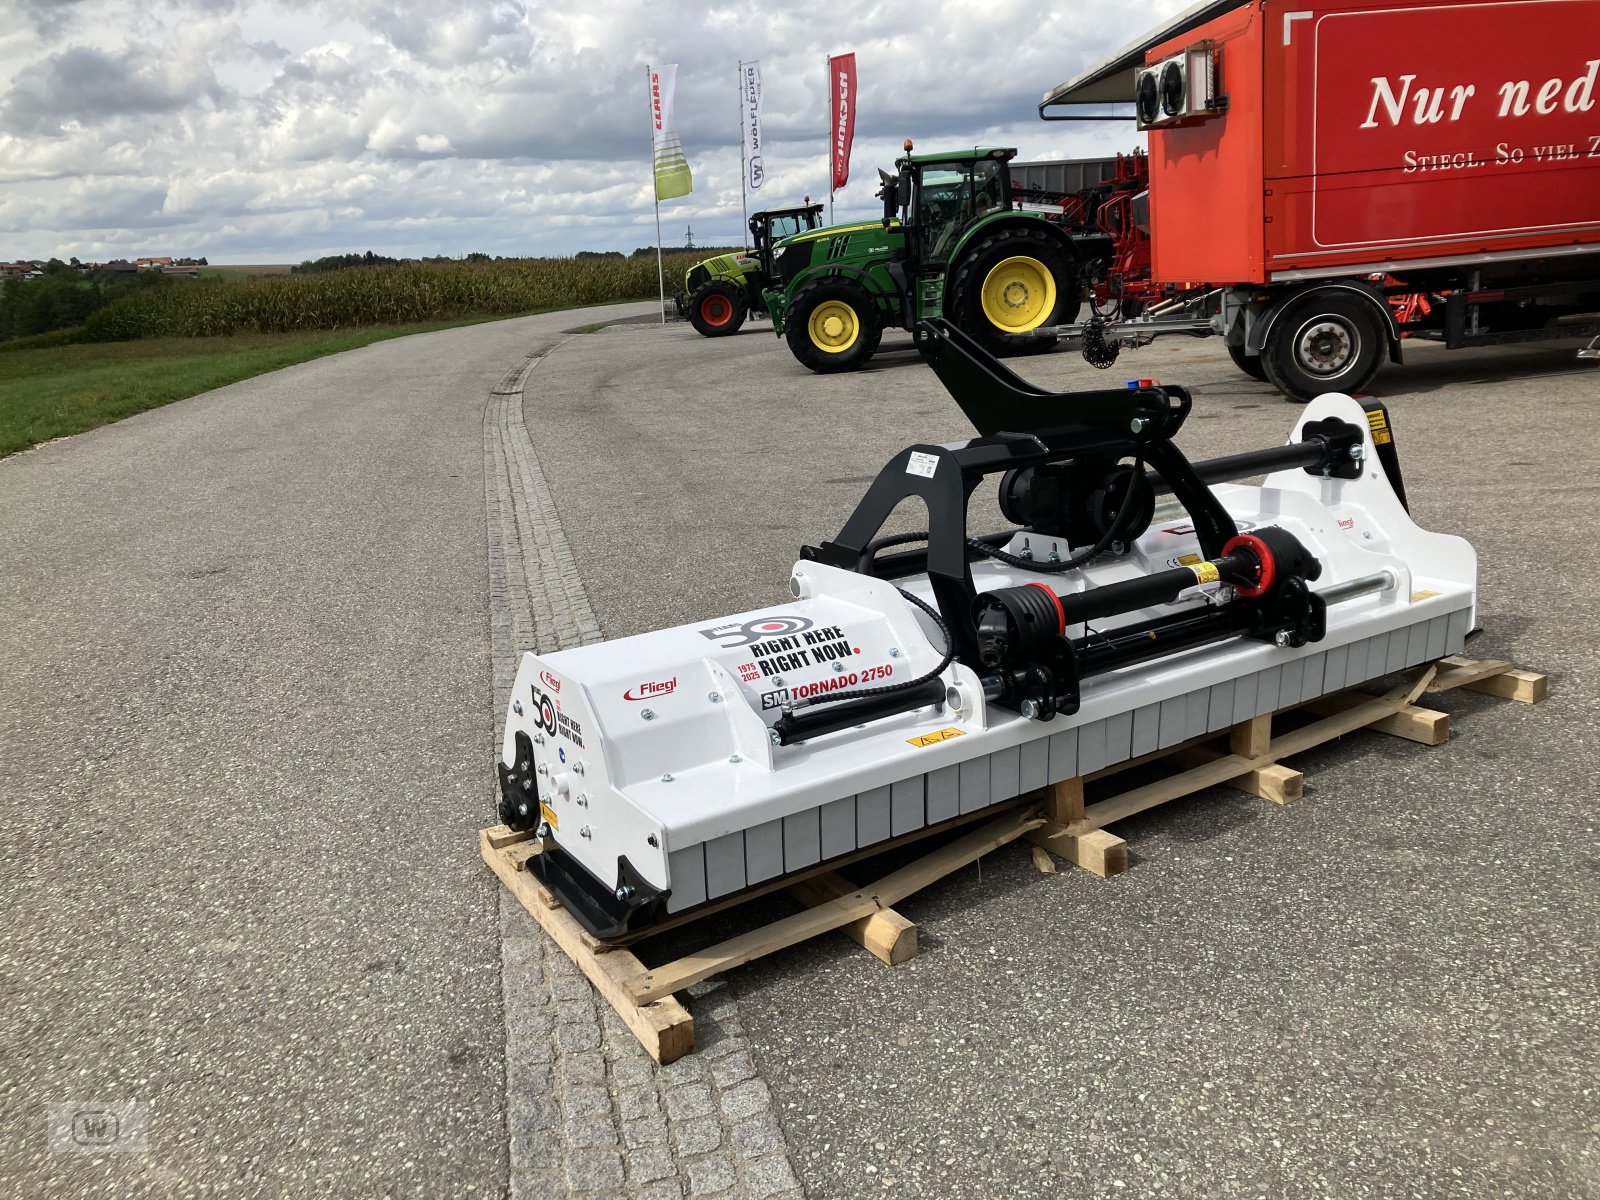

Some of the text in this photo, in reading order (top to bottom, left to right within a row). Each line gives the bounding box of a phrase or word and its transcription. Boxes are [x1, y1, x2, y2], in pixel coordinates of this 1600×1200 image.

[652, 72, 662, 130] CLAAS
[747, 67, 760, 150] WÖLFLEDER
[1360, 59, 1600, 129] Nur ned
[837, 71, 848, 157] HORSCH
[749, 625, 845, 658] RIGHT HERE
[737, 662, 757, 674] 1975
[741, 671, 761, 682] 2025
[758, 650, 811, 677] RIGHT
[640, 677, 677, 696] Fliegl
[790, 673, 858, 701] TORNADO
[861, 664, 893, 683] 2750
